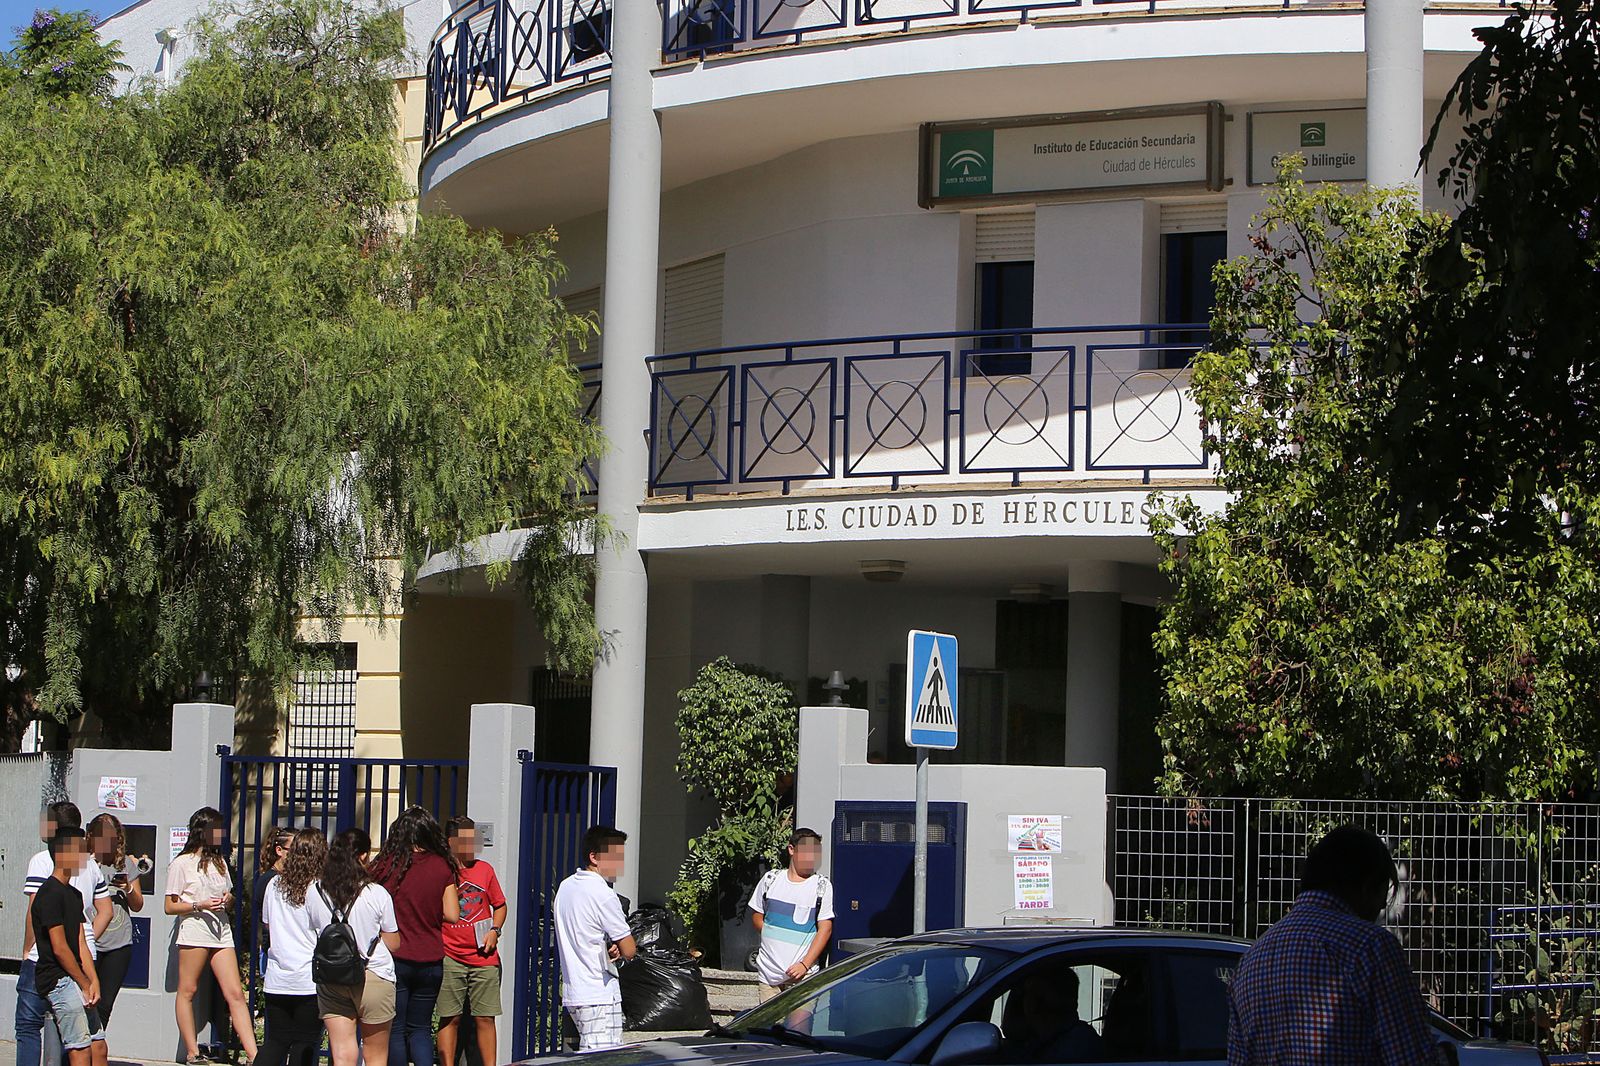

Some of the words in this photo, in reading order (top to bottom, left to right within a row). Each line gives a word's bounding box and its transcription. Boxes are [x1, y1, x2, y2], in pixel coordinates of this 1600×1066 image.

[1033, 142, 1072, 155] Instituto
[1075, 141, 1087, 153] de
[1089, 137, 1139, 151] Educación
[1141, 133, 1196, 147] Secundaria
[1102, 159, 1136, 174] Ciudad
[1138, 158, 1150, 171] de
[1153, 155, 1196, 170] Hércules
[1311, 153, 1356, 168] bilingüe
[841, 503, 938, 530] CIUDAD
[952, 502, 985, 525] DE
[1002, 495, 1151, 525] HÉRCULES
[1018, 900, 1049, 909] TARDE
